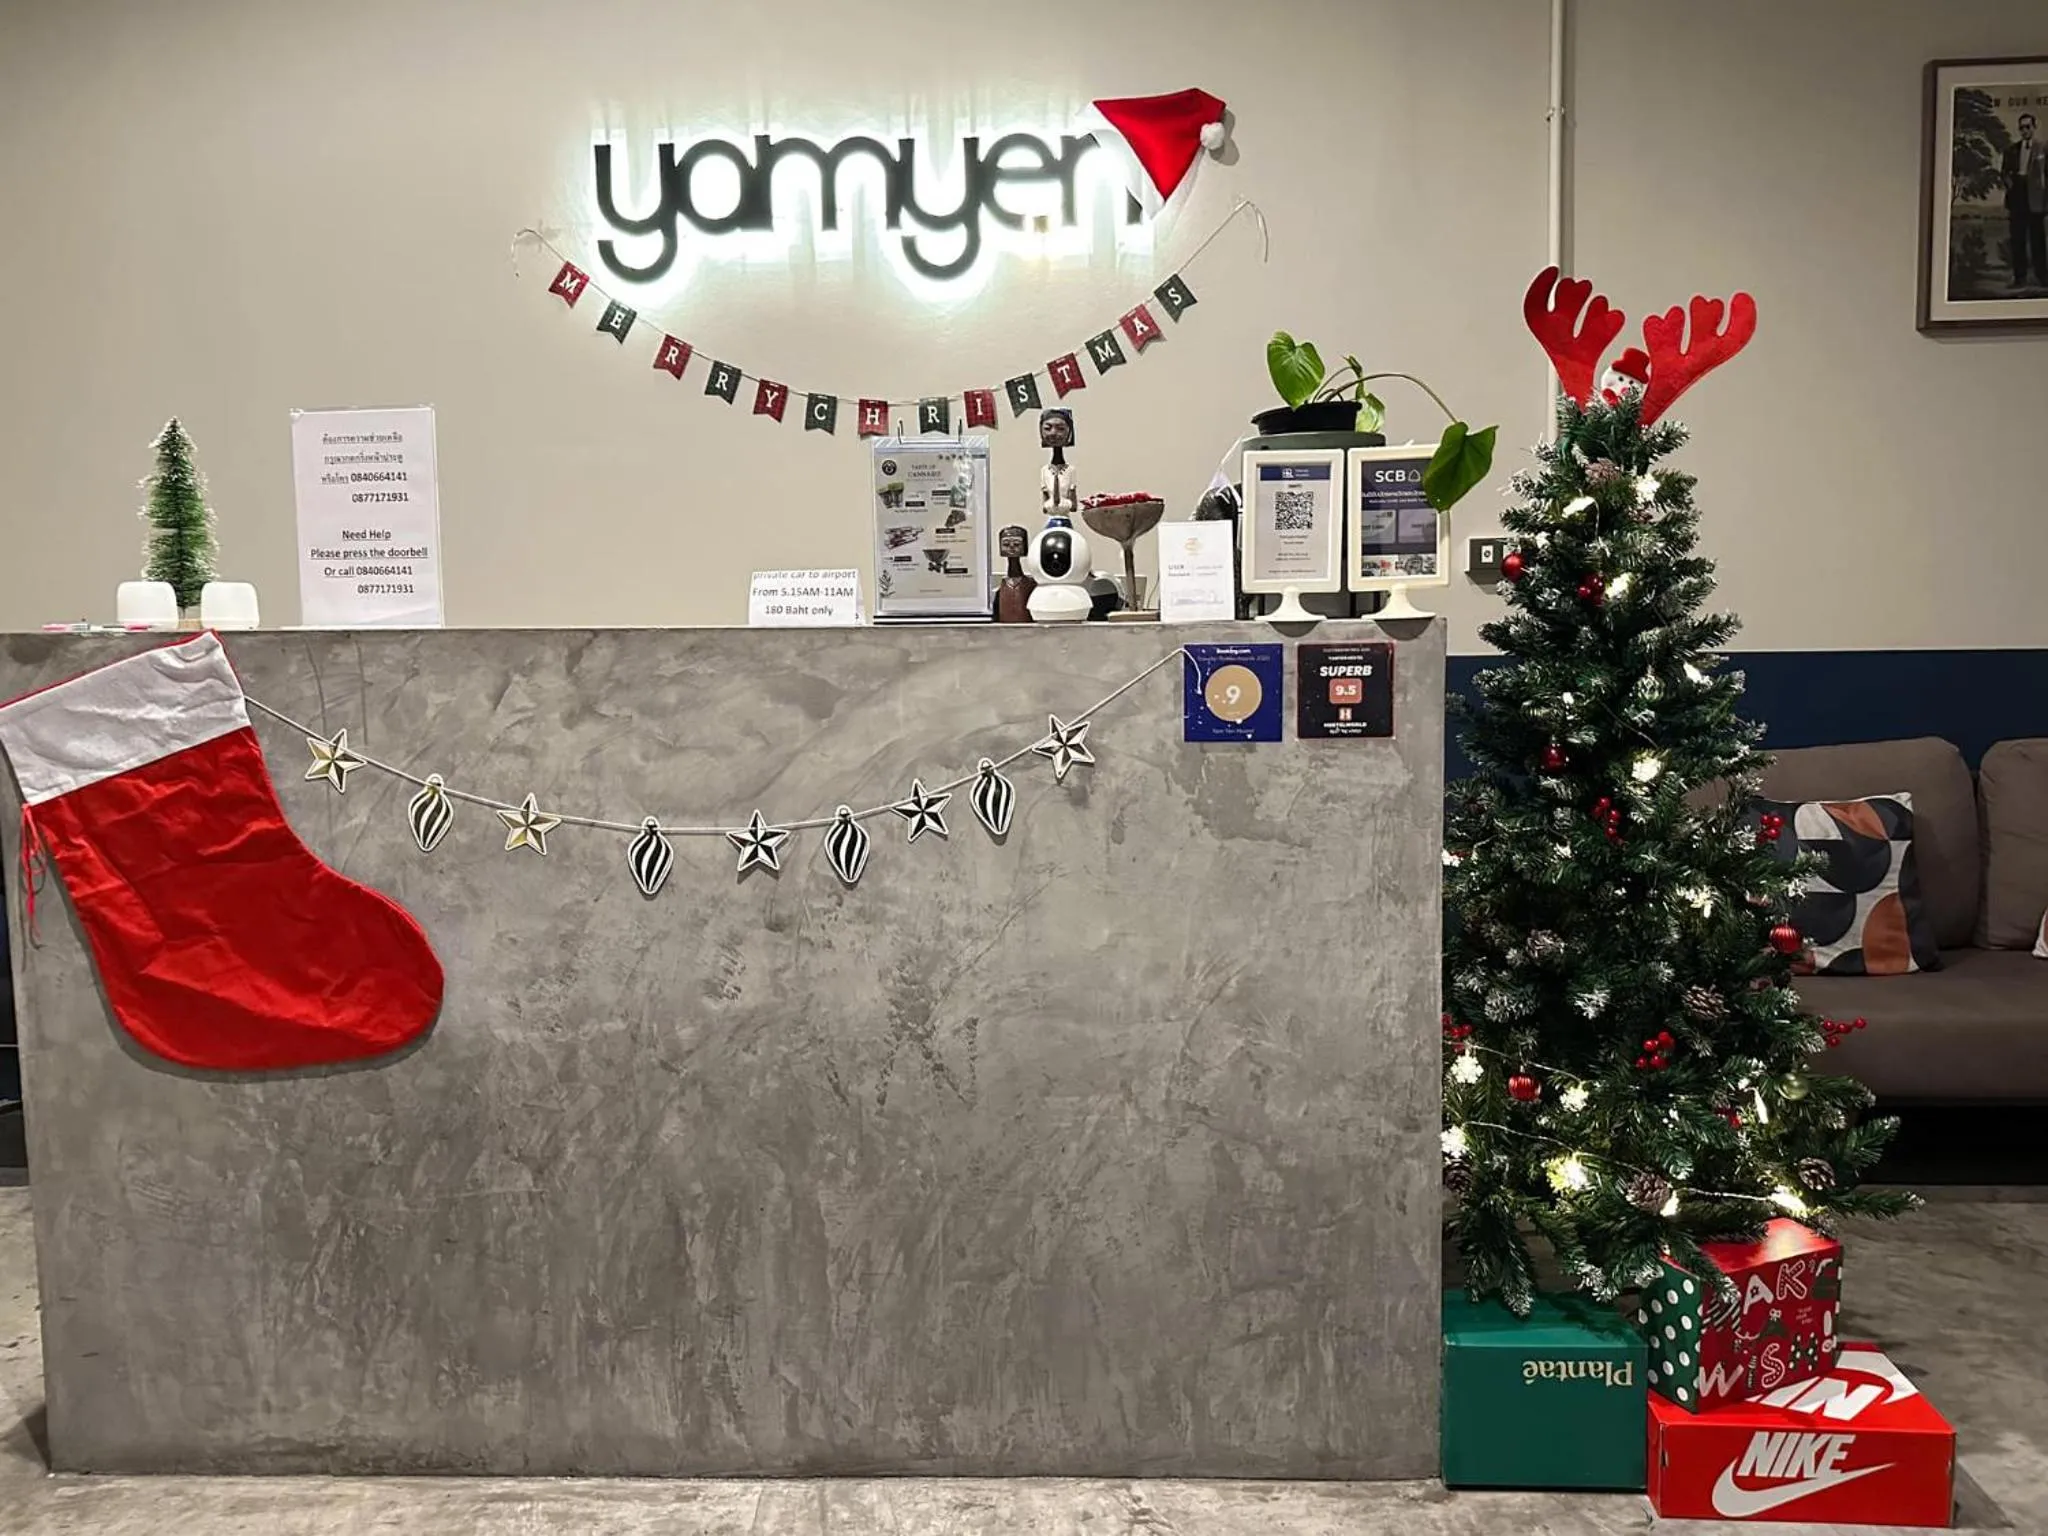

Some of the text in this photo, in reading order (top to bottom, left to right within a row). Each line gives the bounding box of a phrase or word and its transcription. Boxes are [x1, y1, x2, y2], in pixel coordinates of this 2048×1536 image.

[351, 472, 407, 482] 0840664141
[1375, 470, 1406, 483] SCB
[352, 492, 408, 503] 0877171931
[342, 530, 391, 541] Need Help
[311, 547, 427, 560] Please press the doorbell
[324, 565, 412, 576] Or call 0840664141
[809, 571, 819, 579] to
[822, 570, 856, 580] airport
[357, 584, 414, 594] 0877171931
[752, 588, 778, 597] From
[765, 605, 833, 616] 180 Baht only
[1320, 665, 1373, 677] SUPERB
[1226, 685, 1240, 704] 9
[1335, 685, 1357, 696] 9.5
[1522, 1360, 1633, 1388] Plantaé
[1737, 1431, 1857, 1478] NIKE
